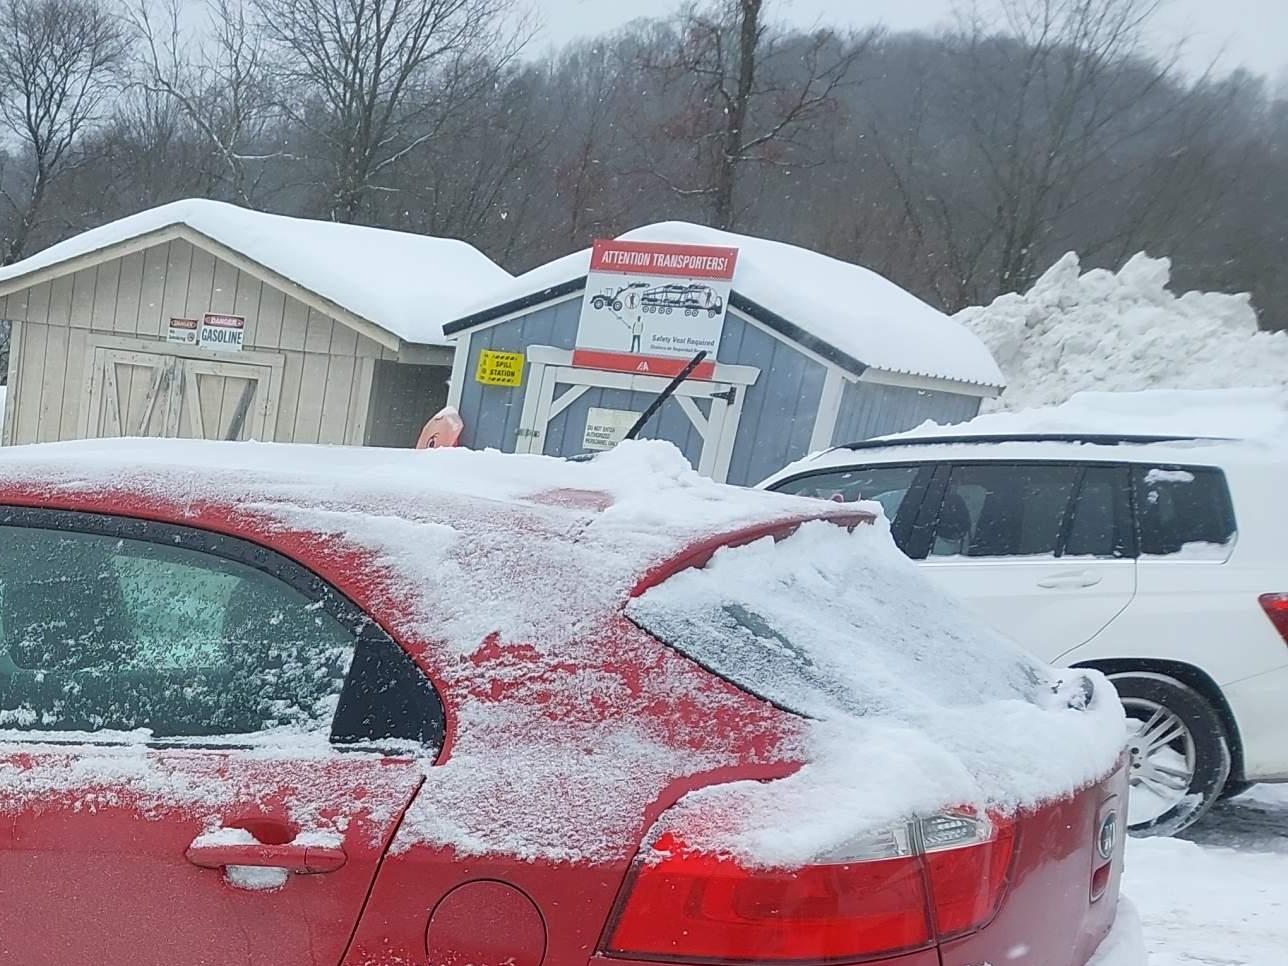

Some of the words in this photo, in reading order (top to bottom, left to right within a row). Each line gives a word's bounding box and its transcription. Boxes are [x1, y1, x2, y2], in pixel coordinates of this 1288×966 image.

[602, 250, 651, 266] ATTENTION
[652, 253, 729, 271] TRANSPORTERS!
[212, 317, 237, 328] DANGER
[201, 328, 243, 344] GASOLINE
[652, 334, 671, 344] Safety
[673, 336, 686, 344] Vest
[687, 337, 715, 347] Required
[496, 361, 512, 369] SPILL
[490, 369, 516, 377] STATION
